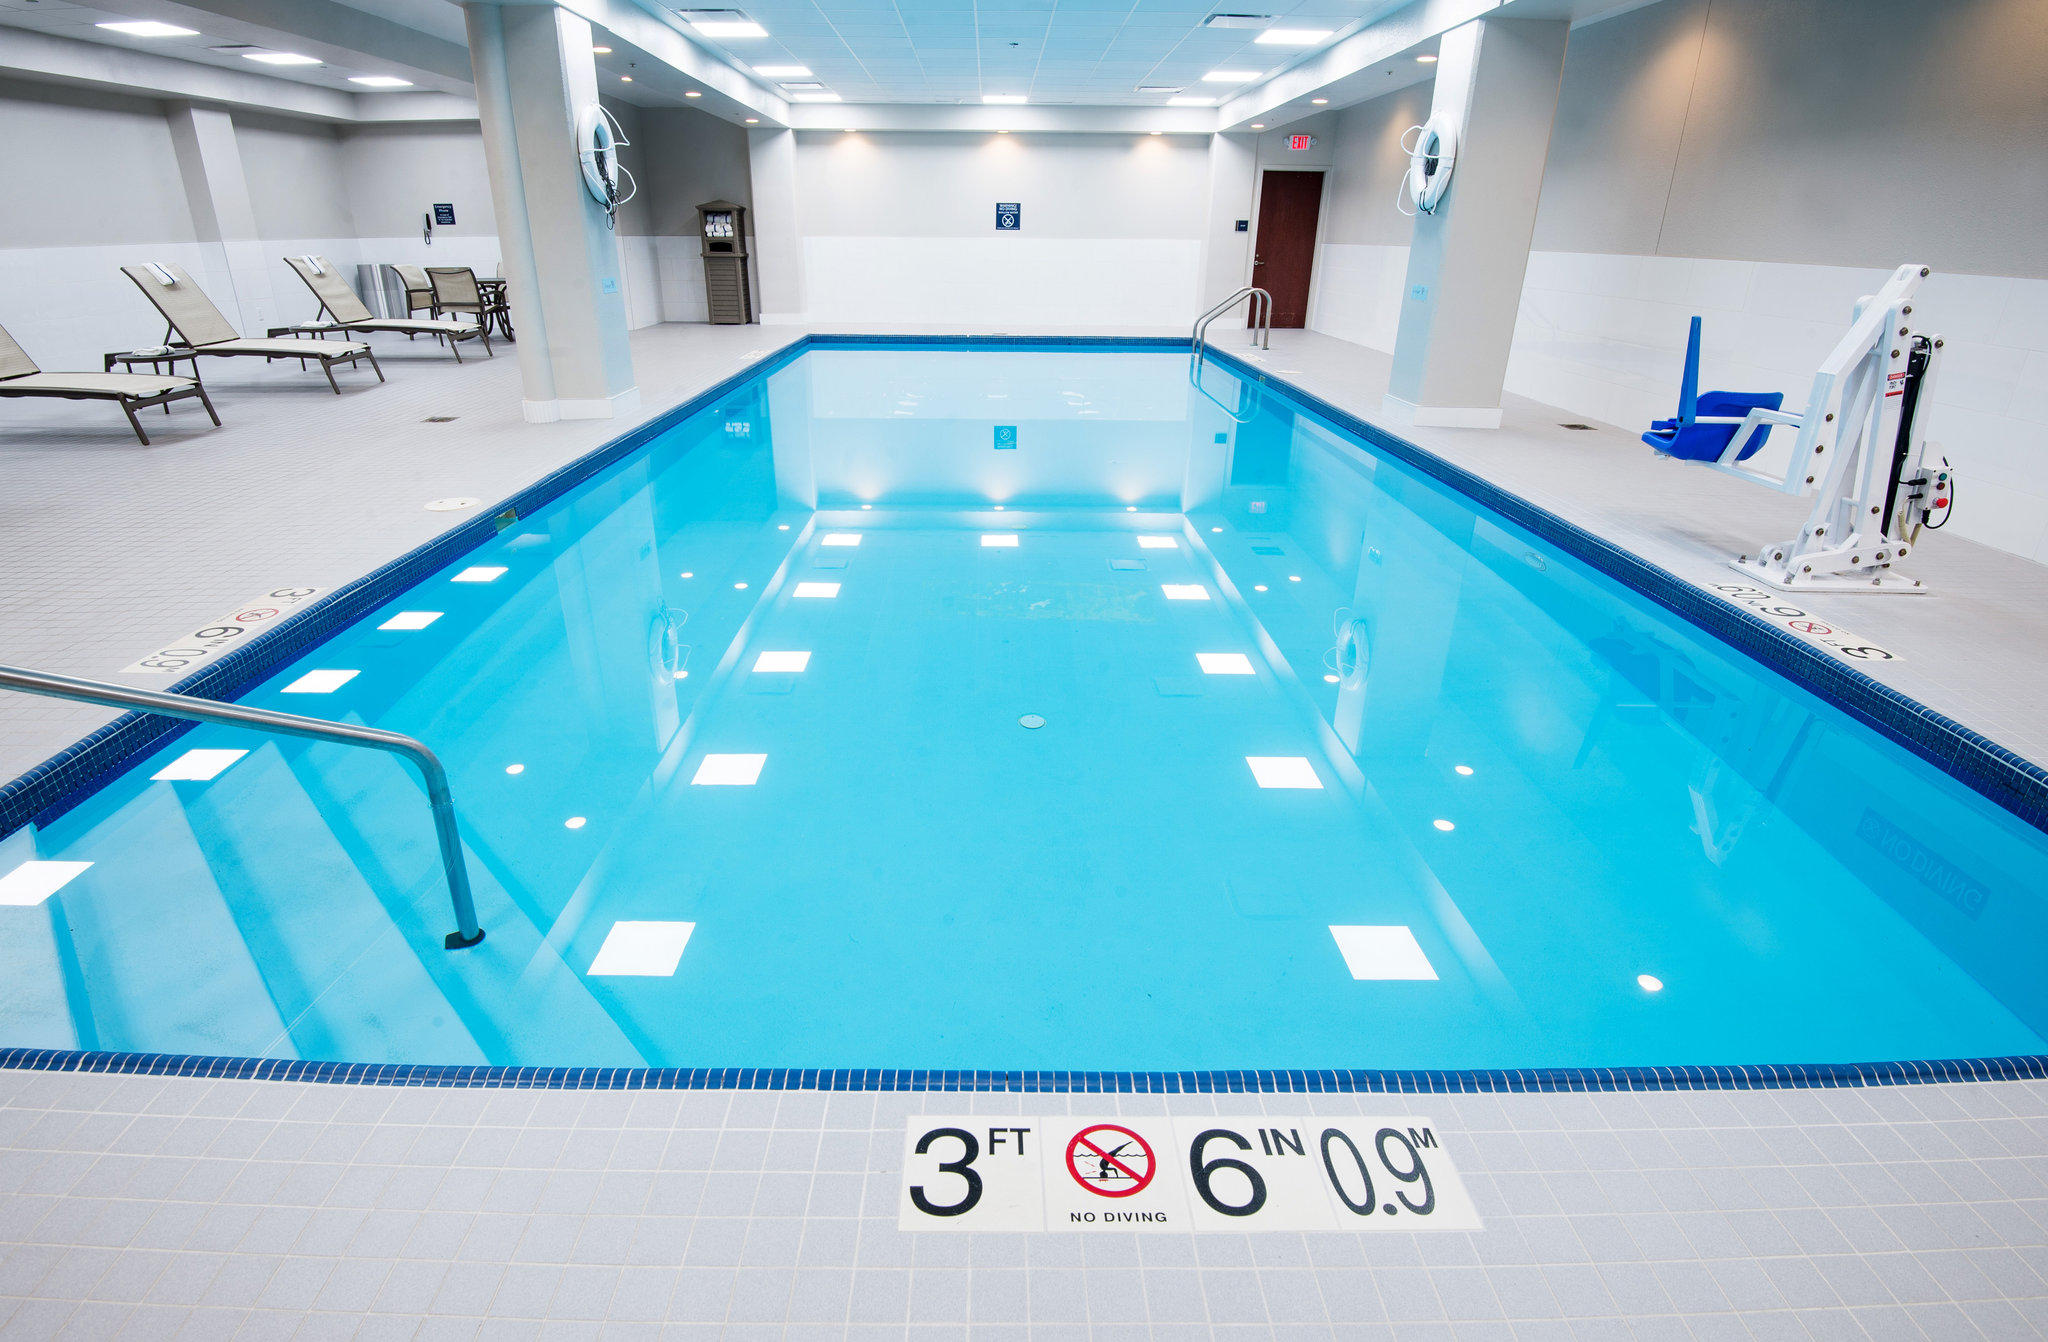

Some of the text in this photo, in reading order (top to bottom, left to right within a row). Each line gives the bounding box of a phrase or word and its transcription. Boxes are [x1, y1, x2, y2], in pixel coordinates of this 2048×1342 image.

[1292, 136, 1309, 150] EXIT
[1071, 1212, 1167, 1223] NO DIVING
